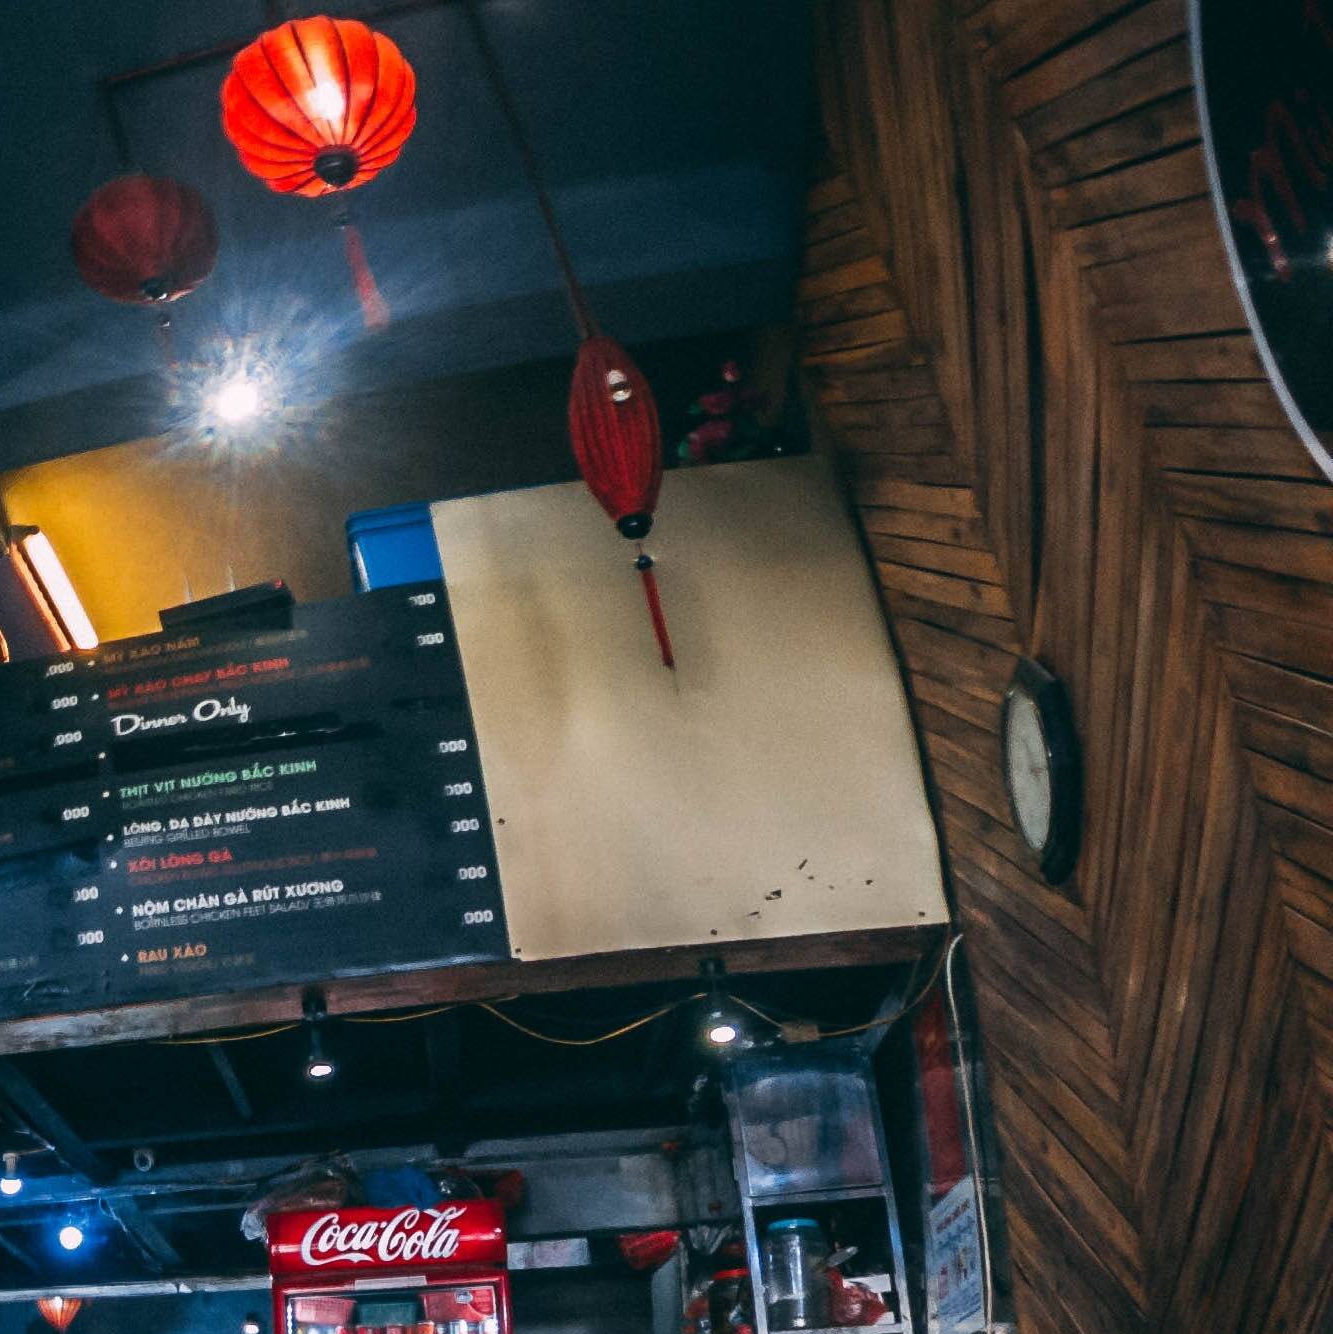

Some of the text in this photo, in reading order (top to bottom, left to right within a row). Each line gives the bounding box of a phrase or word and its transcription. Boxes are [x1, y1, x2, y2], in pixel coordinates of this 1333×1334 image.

[110, 696, 251, 736] Dinner Only
[279, 759, 317, 775] KINH
[315, 797, 350, 813] KINH
[137, 948, 167, 964] RAU
[301, 1206, 467, 1266] Coca-Cola
